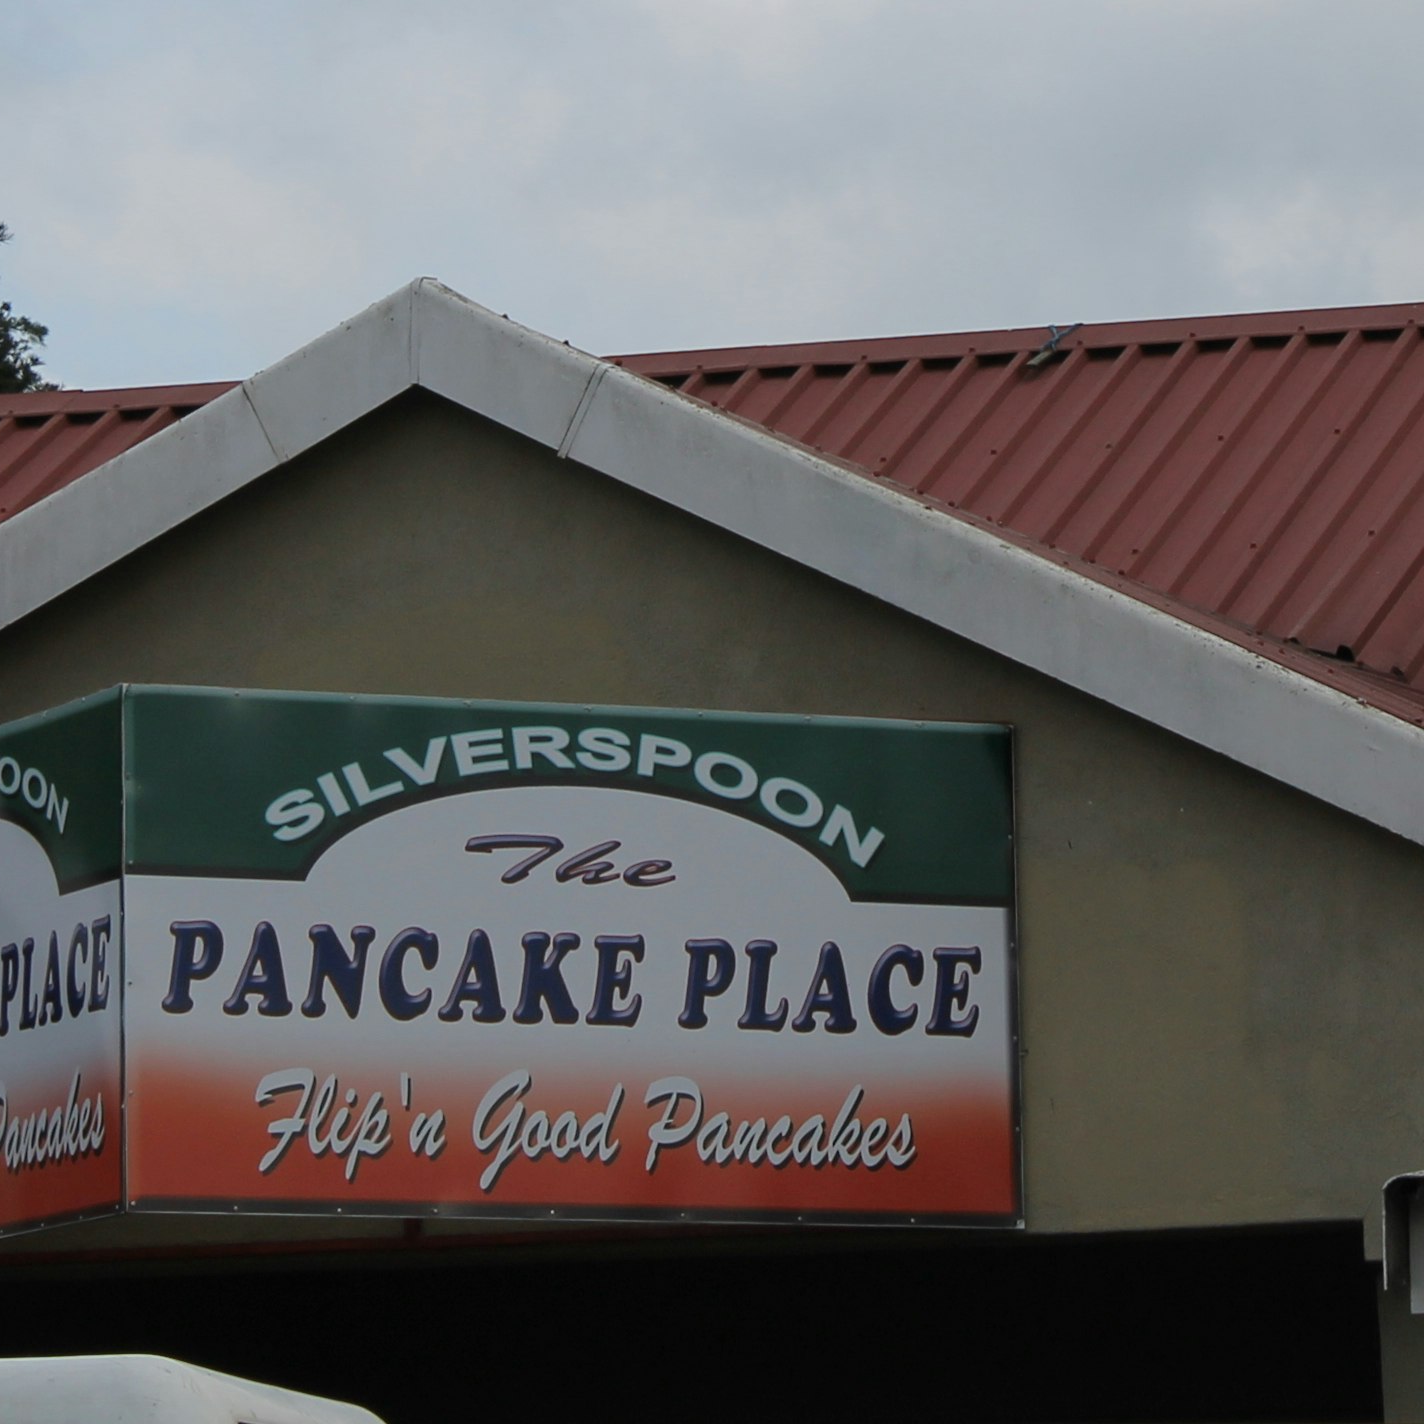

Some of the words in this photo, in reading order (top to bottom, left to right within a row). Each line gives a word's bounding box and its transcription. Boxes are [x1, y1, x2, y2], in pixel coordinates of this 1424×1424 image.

[264, 725, 885, 869] SILVERSPOON
[464, 833, 676, 887] The
[161, 919, 645, 1027] PANCAKE
[678, 938, 981, 1038] PLACE
[255, 1067, 445, 1180] Flip'n
[473, 1068, 624, 1191] Good
[643, 1075, 916, 1173] Pancakes
